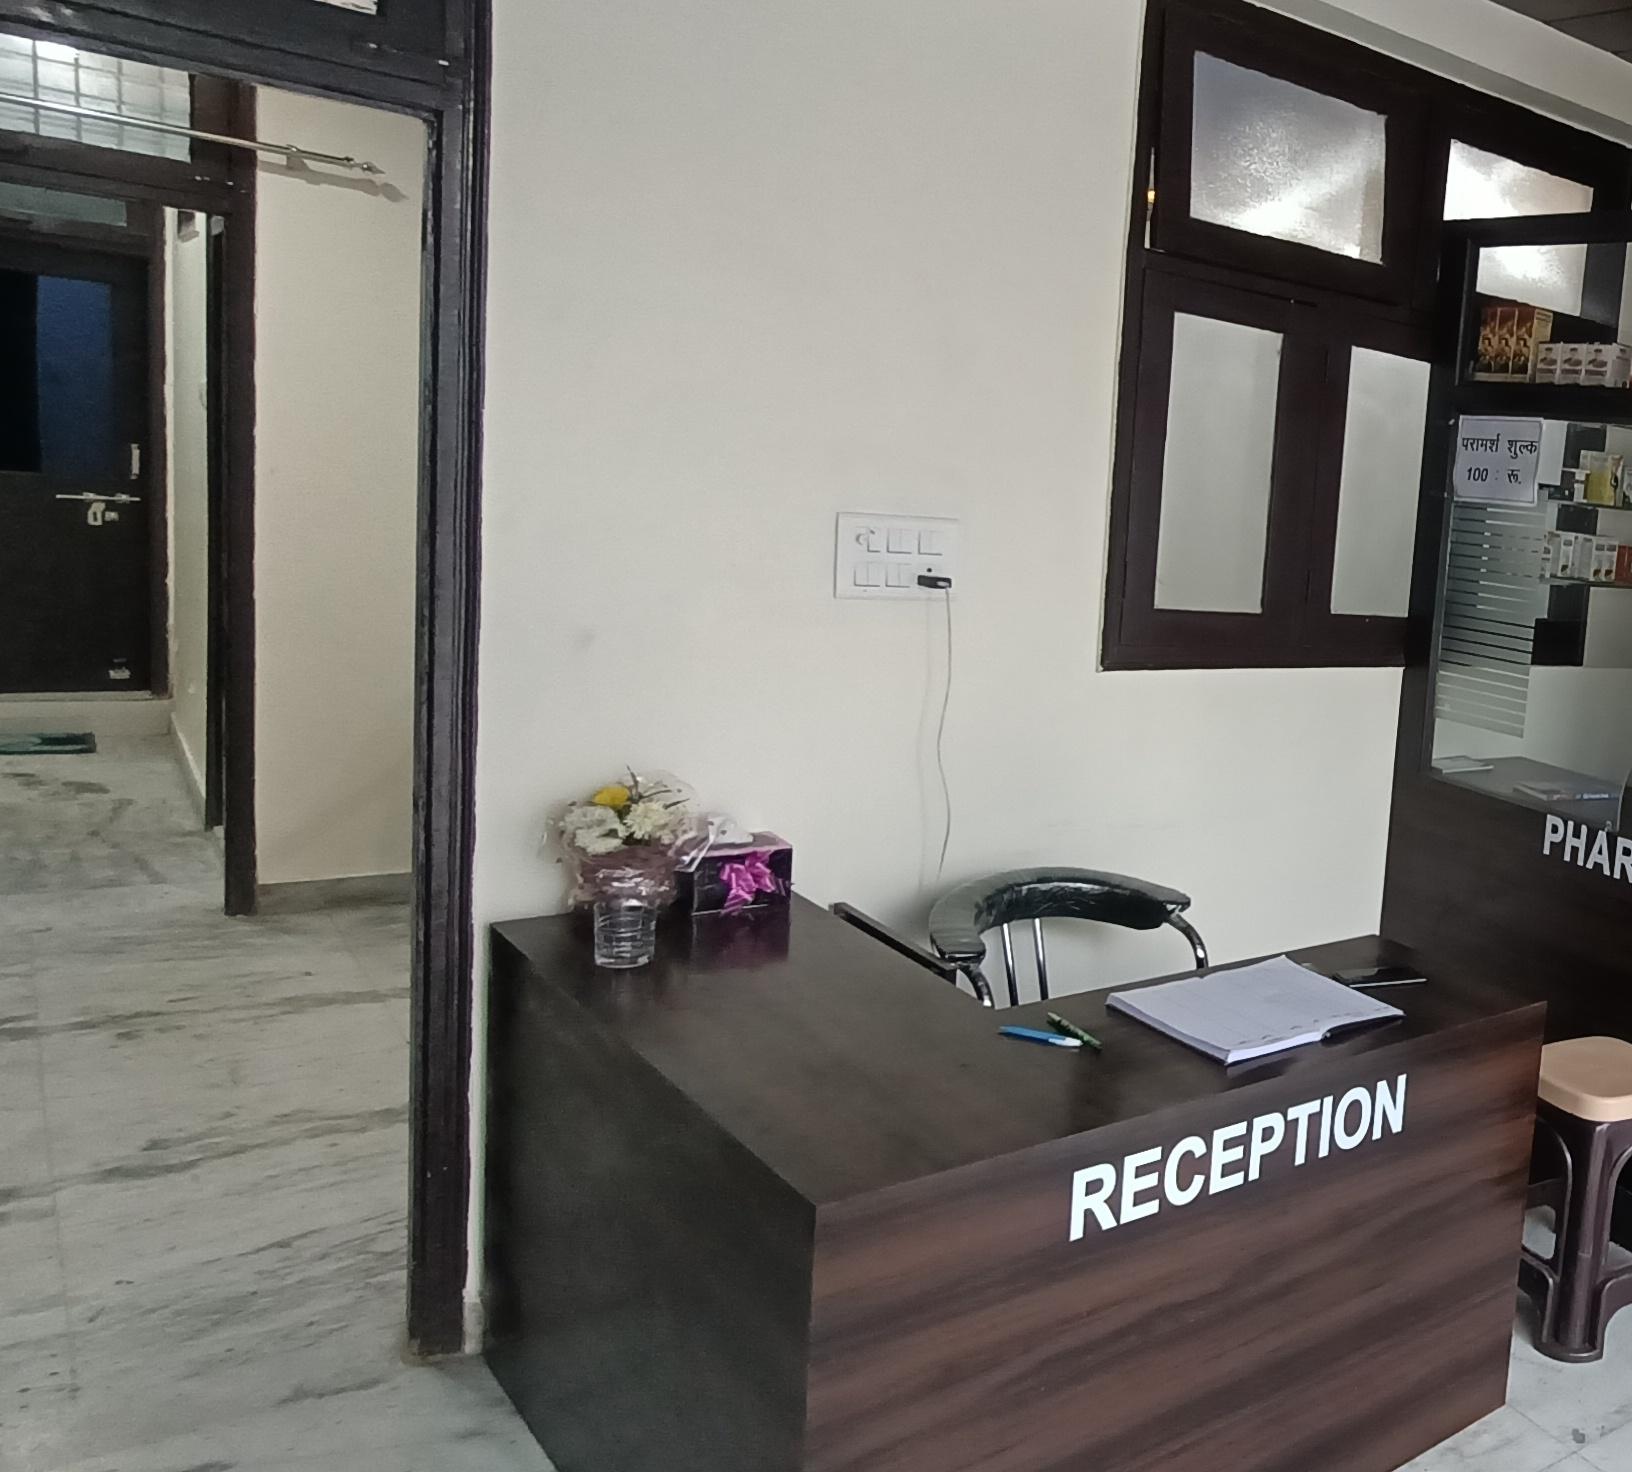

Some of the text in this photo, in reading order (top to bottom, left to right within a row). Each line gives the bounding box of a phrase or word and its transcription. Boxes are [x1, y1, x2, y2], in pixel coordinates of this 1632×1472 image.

[1461, 432, 1540, 460] परामर्श शुल्क
[1466, 466, 1489, 482] 100
[1069, 1073, 1408, 1242] RECEPTION
